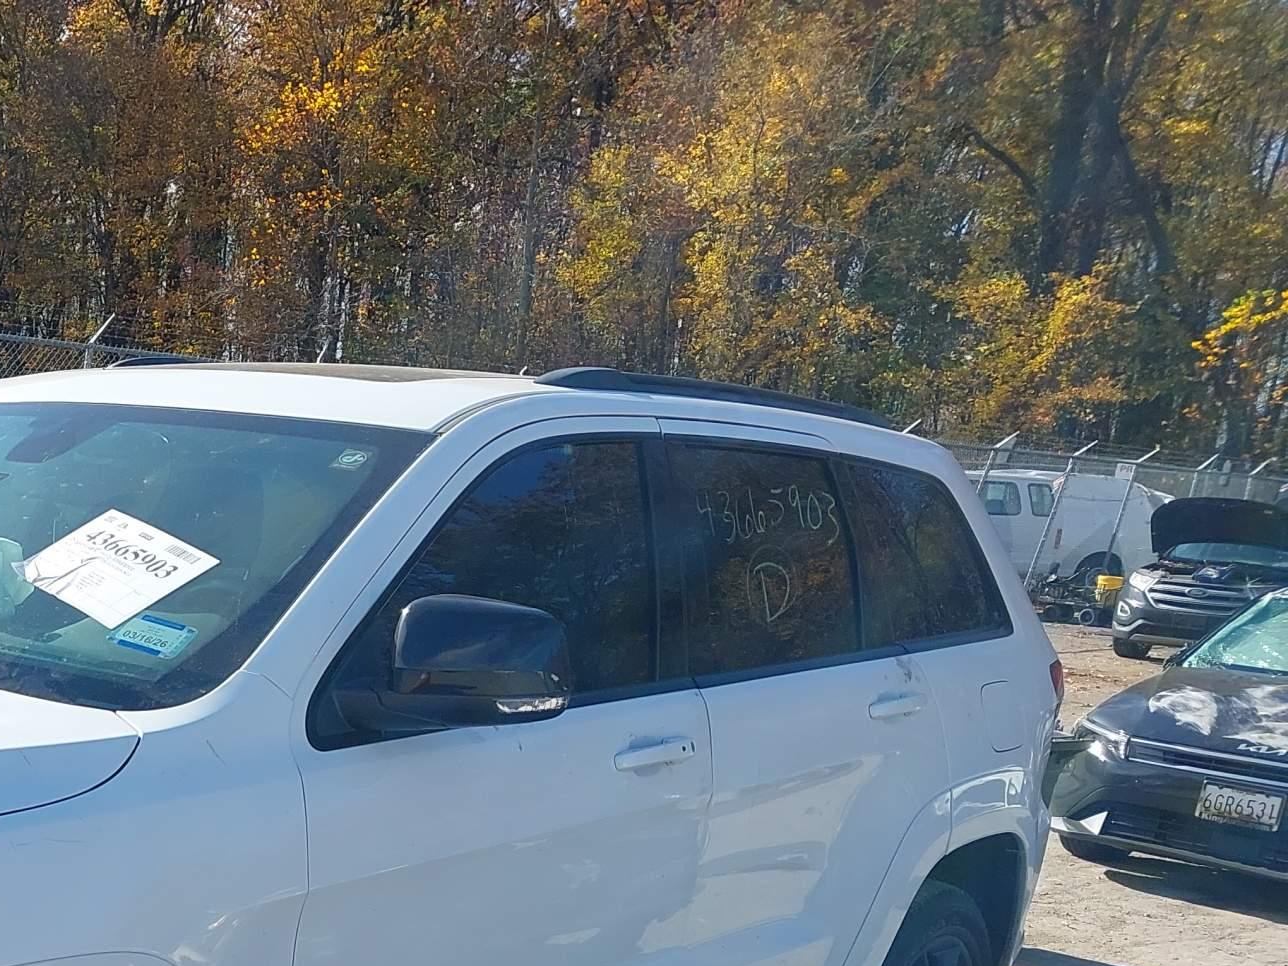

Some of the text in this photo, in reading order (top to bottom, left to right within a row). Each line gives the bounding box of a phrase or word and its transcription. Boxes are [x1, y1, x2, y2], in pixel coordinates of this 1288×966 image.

[696, 484, 840, 545] 43665903
[86, 530, 179, 579] 43665903
[753, 562, 790, 622] D
[123, 630, 169, 648] 03/16/26
[1202, 793, 1276, 821] 6GR6531
